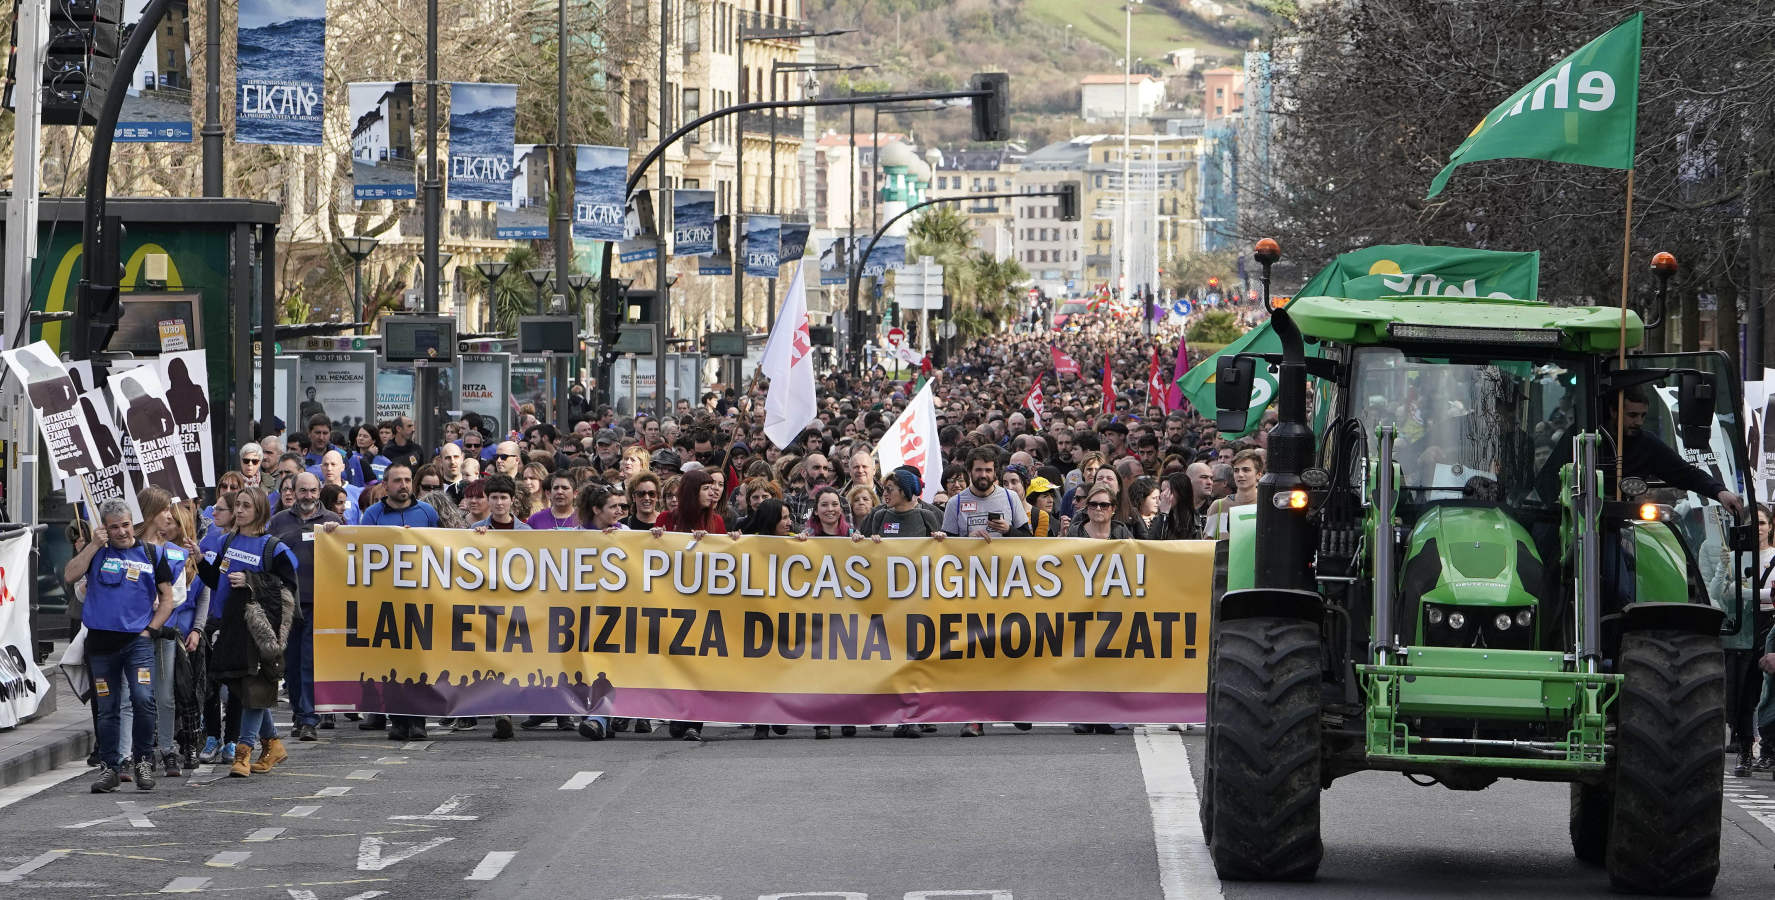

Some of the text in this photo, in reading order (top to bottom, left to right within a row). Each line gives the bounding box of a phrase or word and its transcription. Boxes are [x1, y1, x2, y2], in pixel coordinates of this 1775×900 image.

[145, 460, 165, 474] EGIN
[346, 540, 1146, 599] ¡PENSIONES PÚBLICAS DIGNAS YA!
[346, 600, 1197, 661] LAN ETA BIZITZA DUINA DENONTZAT!
